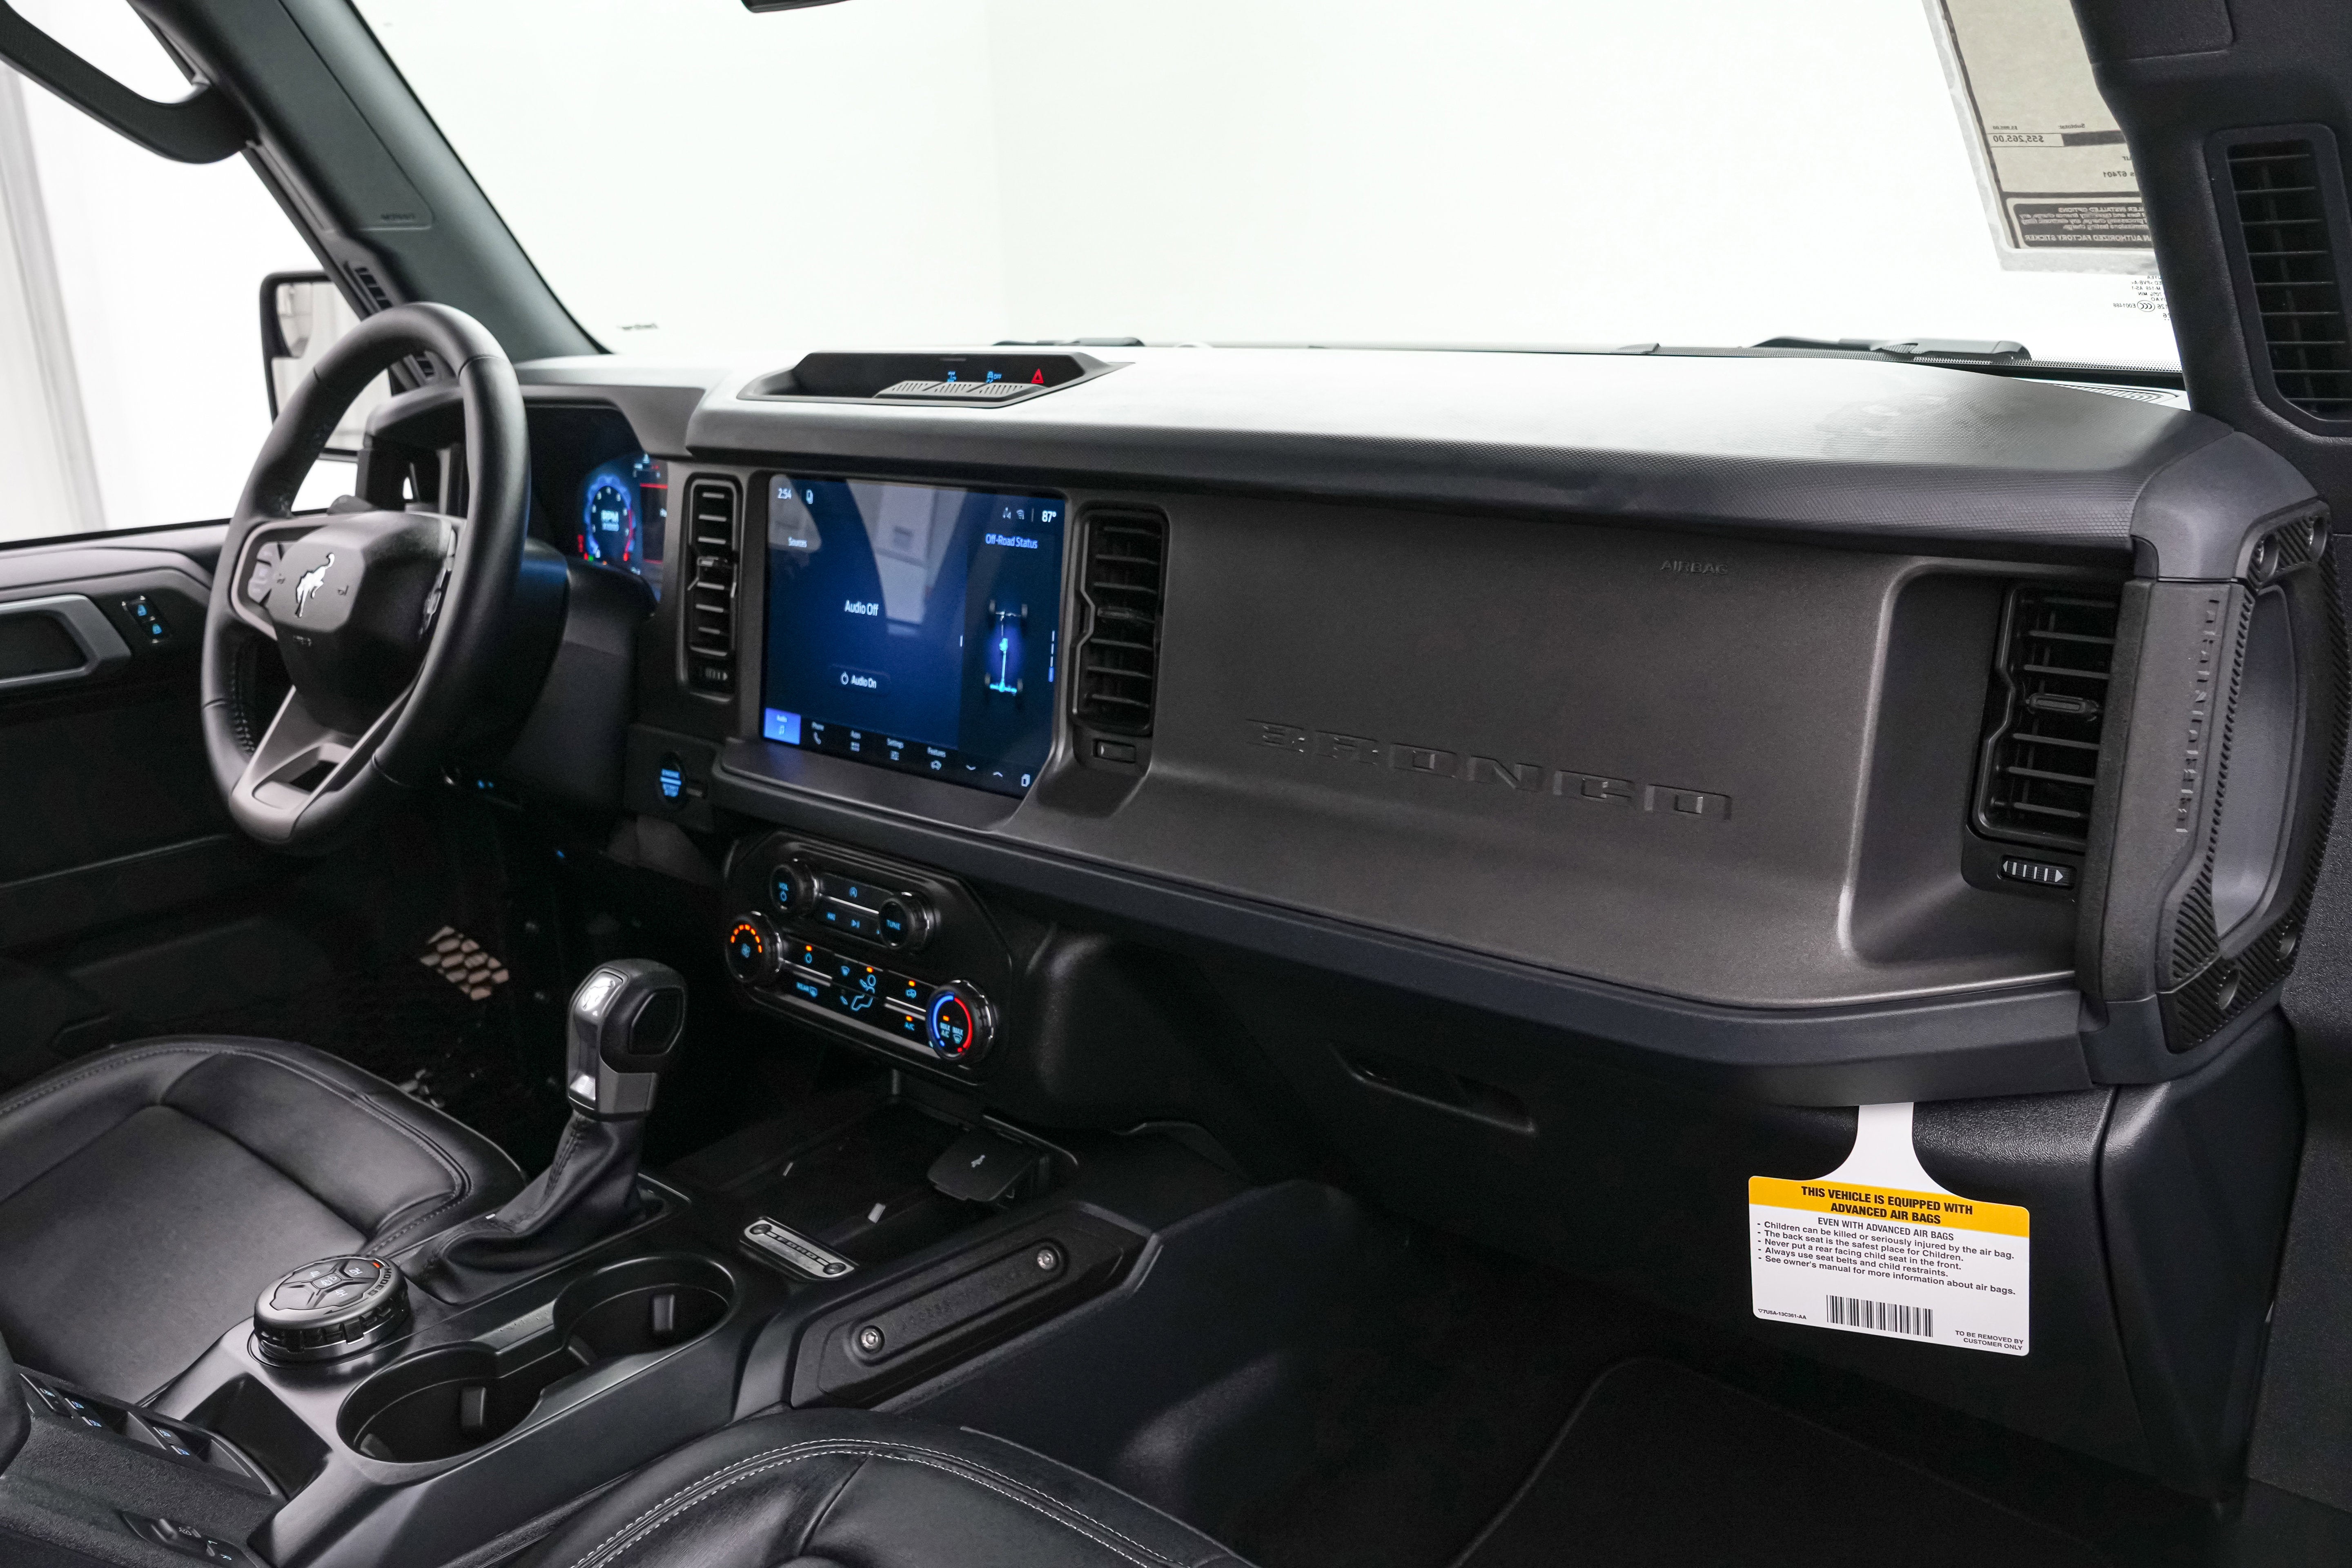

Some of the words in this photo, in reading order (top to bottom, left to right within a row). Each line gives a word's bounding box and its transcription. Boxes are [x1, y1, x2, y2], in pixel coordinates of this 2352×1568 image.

[985, 533, 1016, 547] Off-Road
[1015, 536, 1038, 549] Status
[1659, 560, 1729, 575] AIRBAG
[844, 599, 866, 615] Audio
[866, 602, 879, 616] Off
[850, 674, 868, 687] Audio
[867, 677, 877, 689] On
[1245, 718, 1732, 822] BRONCO
[886, 919, 901, 931] TUNE
[904, 1022, 915, 1031] A/C
[1801, 1185, 1825, 1198] THIS
[1828, 1189, 1871, 1203] VEHICLE
[1874, 1194, 1884, 1205] IS
[1888, 1196, 1940, 1211] EQUIPPED
[1944, 1202, 1973, 1215] WITH
[1831, 1203, 1887, 1218] ADVANCED
[1890, 1209, 1908, 1221] AIR
[1912, 1212, 1941, 1224] BAGS
[1818, 1217, 1839, 1227] EVEN
[1842, 1220, 1863, 1230] WITH
[1866, 1223, 1911, 1236] ADVANCED
[1913, 1229, 1928, 1238] AIR
[1931, 1231, 1954, 1241] BAGS
[1764, 1221, 1800, 1232] Children
[1821, 1228, 1831, 1236] be
[1834, 1229, 1857, 1239] killed
[1871, 1236, 1912, 1247] seriously
[1915, 1240, 1946, 1250] injured
[1949, 1244, 1960, 1254] by
[1962, 1246, 1977, 1254] the
[1994, 1250, 2014, 1260] bag.
[1764, 1229, 1780, 1238] The
[1783, 1232, 1803, 1241] back
[1852, 1242, 1878, 1250] safest
[1881, 1245, 1904, 1254] place
[1907, 1247, 1920, 1256] for
[1922, 1250, 1963, 1261] Children.
[1765, 1238, 1789, 1247] Never
[1835, 1247, 1862, 1258] facing
[1864, 1252, 1885, 1260] child
[1920, 1258, 1934, 1267] the
[1937, 1260, 1961, 1270] front.
[1765, 1247, 1795, 1258] Always
[1836, 1256, 1857, 1265] belts
[1879, 1262, 1900, 1271] child
[1903, 1266, 1948, 1277] restraints.
[348, 1267, 363, 1276] 2H
[1765, 1255, 1781, 1264] See
[1783, 1259, 1817, 1268] owner's
[1819, 1263, 1851, 1272] manual
[1853, 1267, 1865, 1275] for
[1868, 1270, 1890, 1278] more
[1893, 1272, 1944, 1285] information
[1947, 1280, 1973, 1290] about
[1990, 1285, 2016, 1295] bags.
[368, 1268, 392, 1296] MODES
[335, 1289, 348, 1297] 4H
[1762, 1309, 1807, 1320] 7U5A-13C361-AA
[1963, 1337, 2002, 1348] CUSTOMER
[1978, 1333, 2012, 1343] REMOVED
